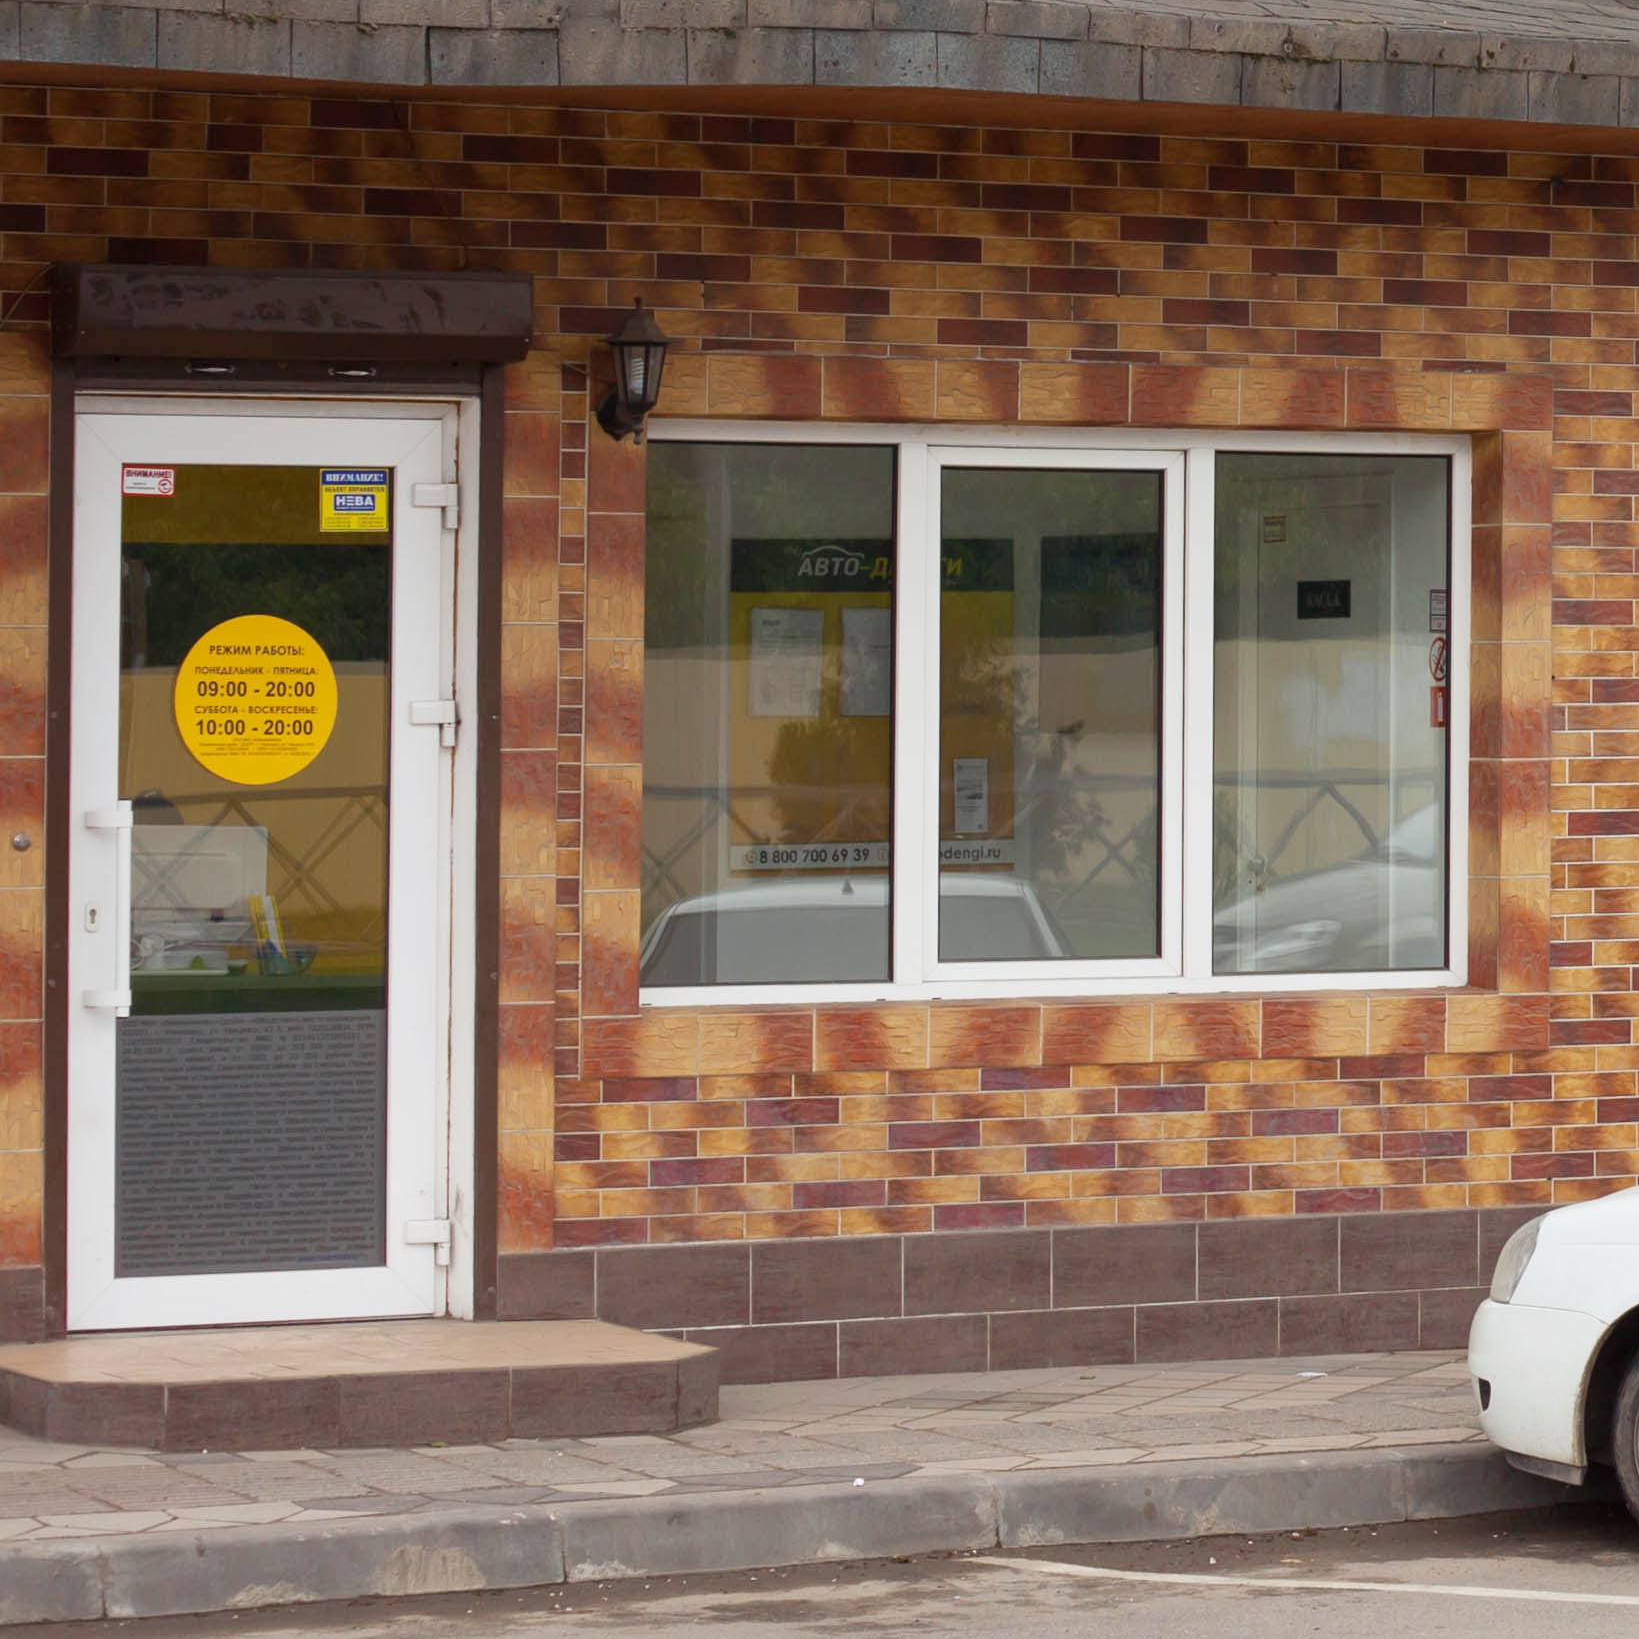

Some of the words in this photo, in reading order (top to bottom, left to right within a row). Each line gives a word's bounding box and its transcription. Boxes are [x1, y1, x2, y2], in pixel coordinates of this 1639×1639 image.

[209, 645, 251, 655] РЕЖИМ
[255, 645, 305, 656] РАБОТЫ:
[195, 666, 264, 675] ПОНЕДЕЛЬНИК
[197, 681, 247, 697] 09:00
[265, 681, 315, 697] 20:00
[194, 705, 239, 714] СУББОТА
[196, 719, 245, 735] 10:00
[263, 719, 313, 735] 20:00
[759, 850, 768, 863] 8
[772, 850, 798, 863] 800
[802, 849, 828, 863] 700
[831, 849, 848, 862] 69
[853, 848, 870, 862] 39
